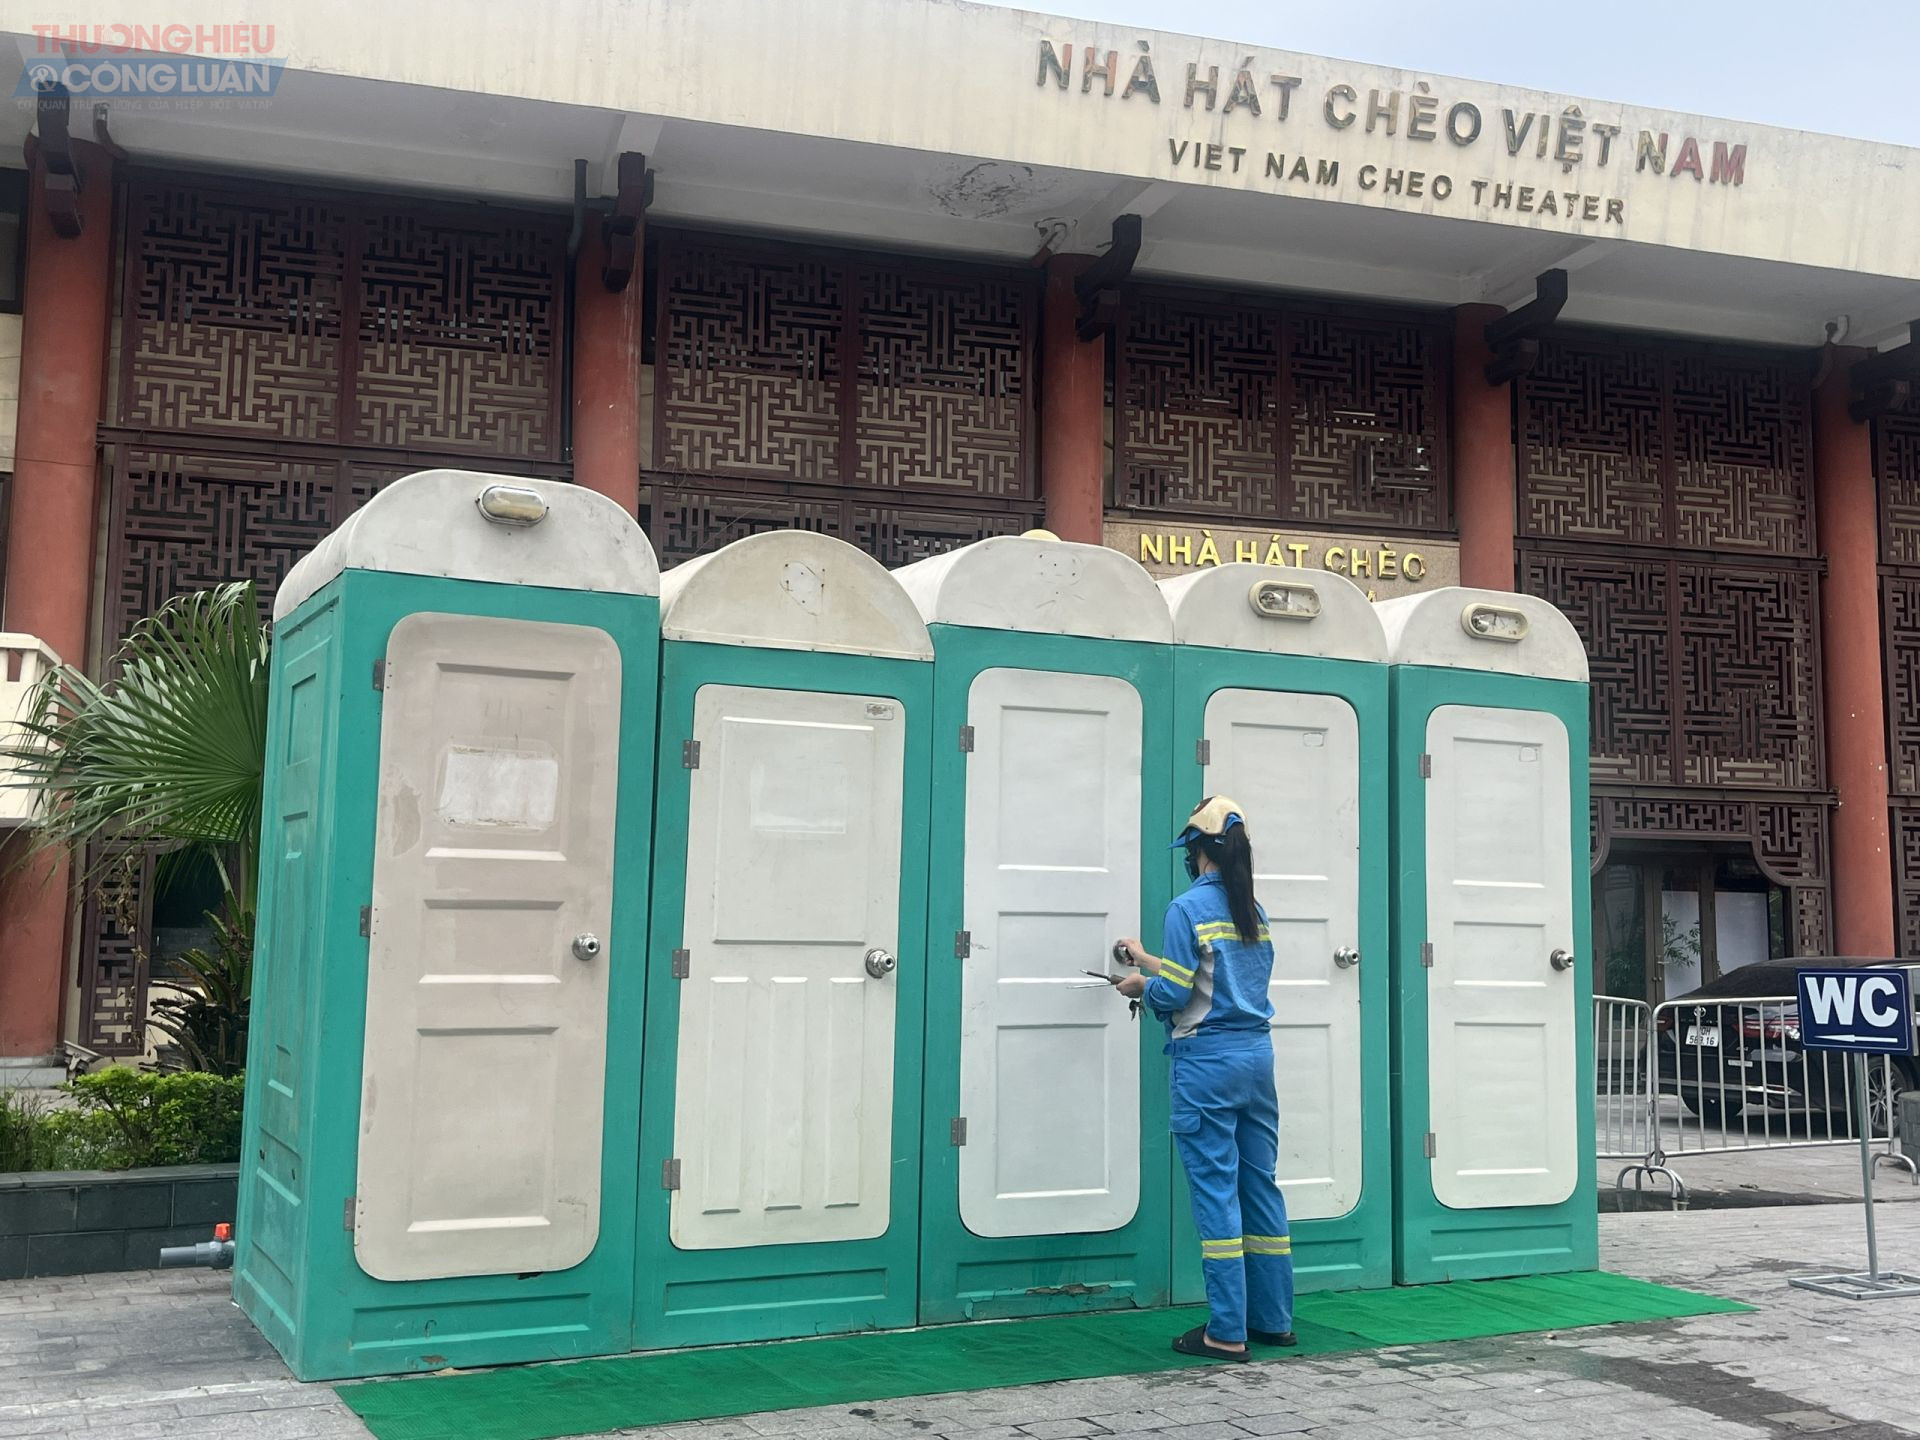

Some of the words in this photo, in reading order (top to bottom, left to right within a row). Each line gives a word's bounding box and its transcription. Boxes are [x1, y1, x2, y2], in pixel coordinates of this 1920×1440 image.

[1037, 39, 1161, 104] NHÀ
[1183, 56, 1302, 121] HÁT
[1323, 80, 1482, 146] CHÈO
[1502, 104, 1621, 173] VIỆT
[1635, 130, 1748, 187] NAM
[1168, 138, 1247, 174] VIET
[1265, 152, 1340, 187] NAM
[1358, 164, 1453, 200] CHEO
[1471, 179, 1625, 224] THEATER
[1140, 530, 1221, 566] NHÀ
[1235, 534, 1309, 568] HÁT
[1324, 543, 1427, 582] CHÈO
[1804, 977, 1900, 1028] WC
